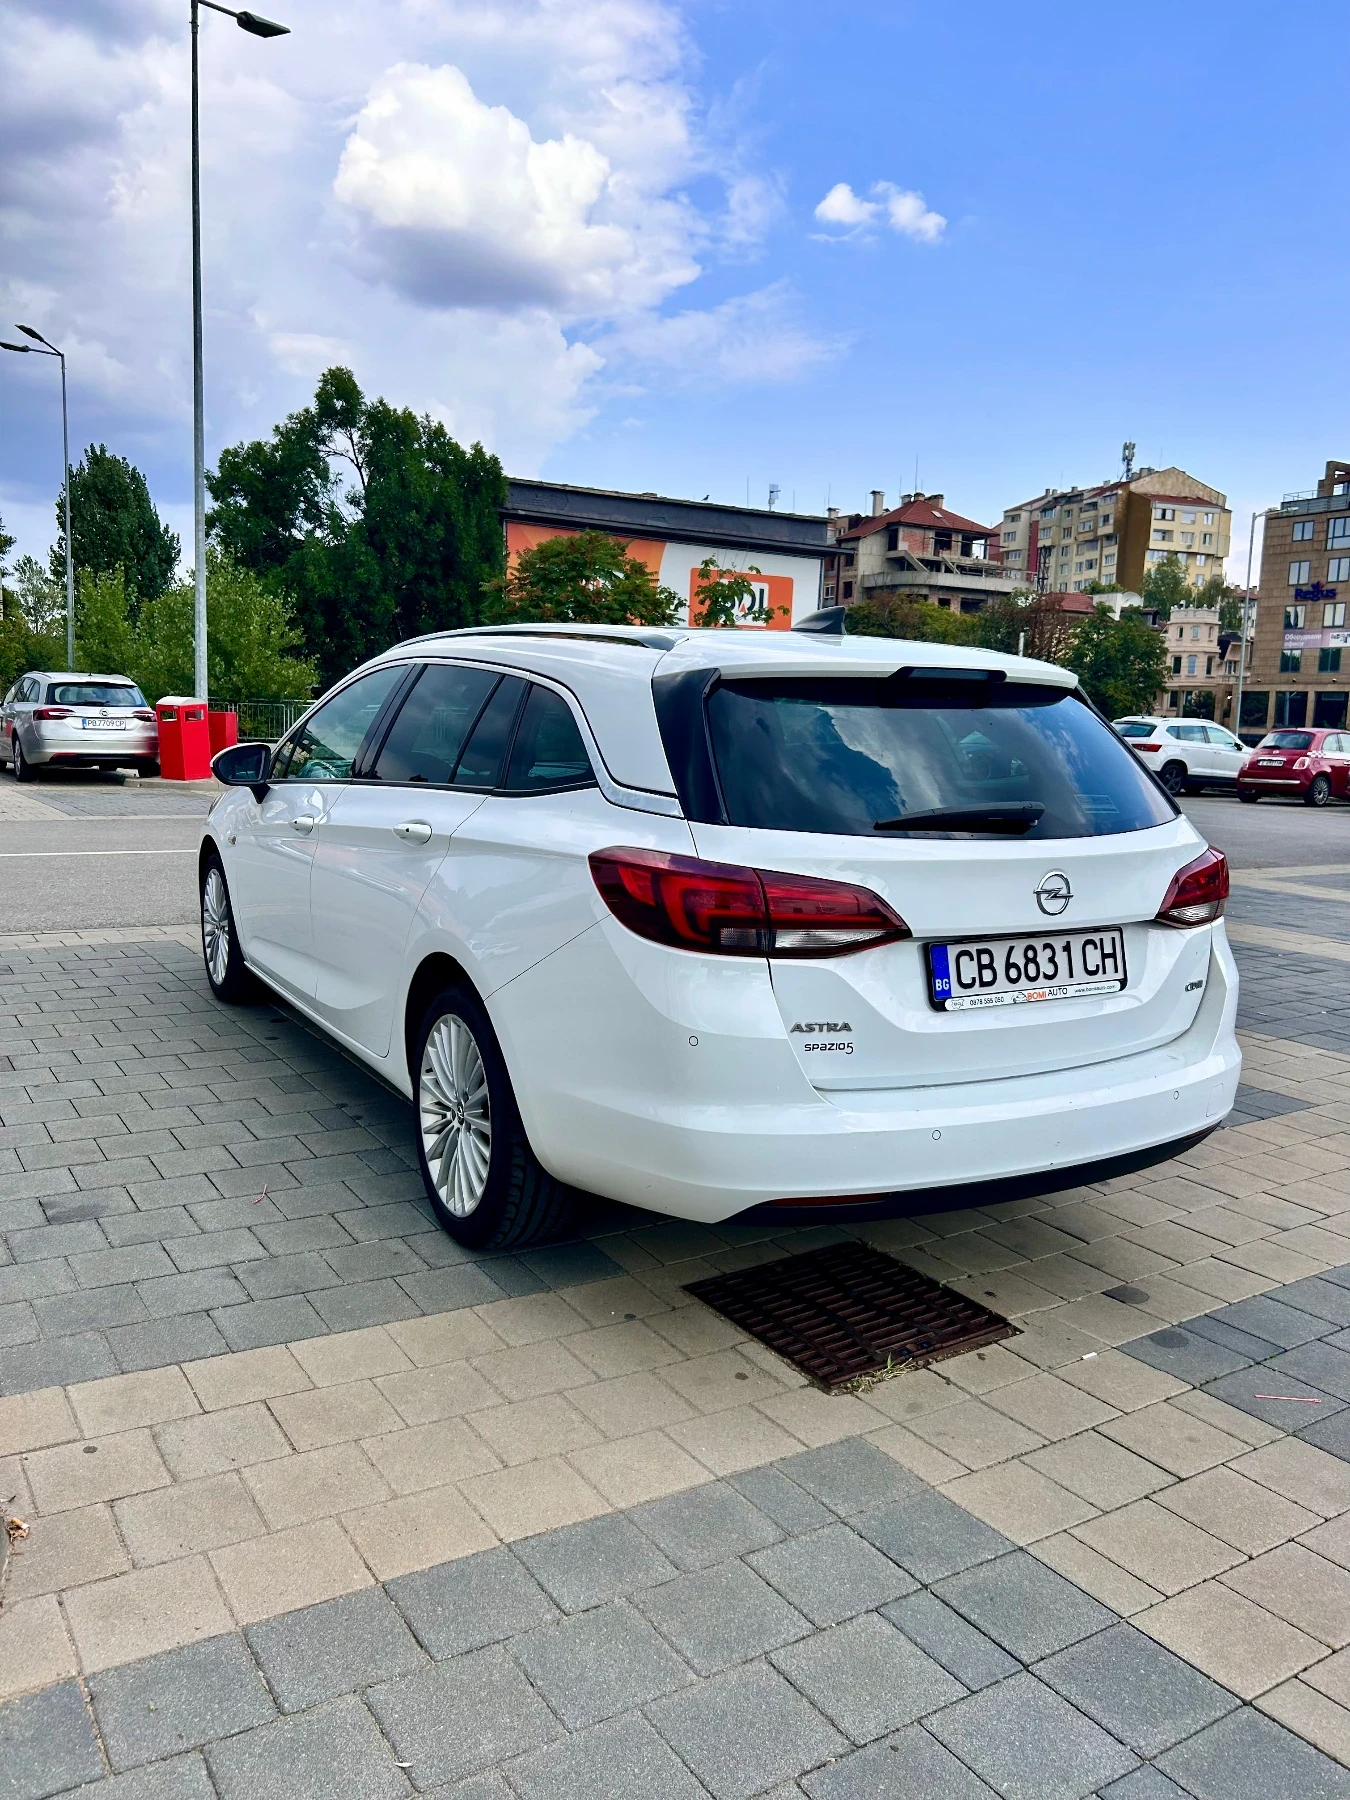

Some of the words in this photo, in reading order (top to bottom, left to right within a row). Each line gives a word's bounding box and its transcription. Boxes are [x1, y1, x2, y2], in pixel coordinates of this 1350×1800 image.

[1295, 588, 1337, 602] Regus
[955, 947, 998, 990] CB
[1004, 940, 1074, 985] 6831
[1081, 936, 1119, 977] CH
[935, 979, 950, 991] BG
[1026, 991, 1047, 1001] BOMI
[1047, 987, 1068, 998] AUTO
[790, 1021, 853, 1034] ASTRA
